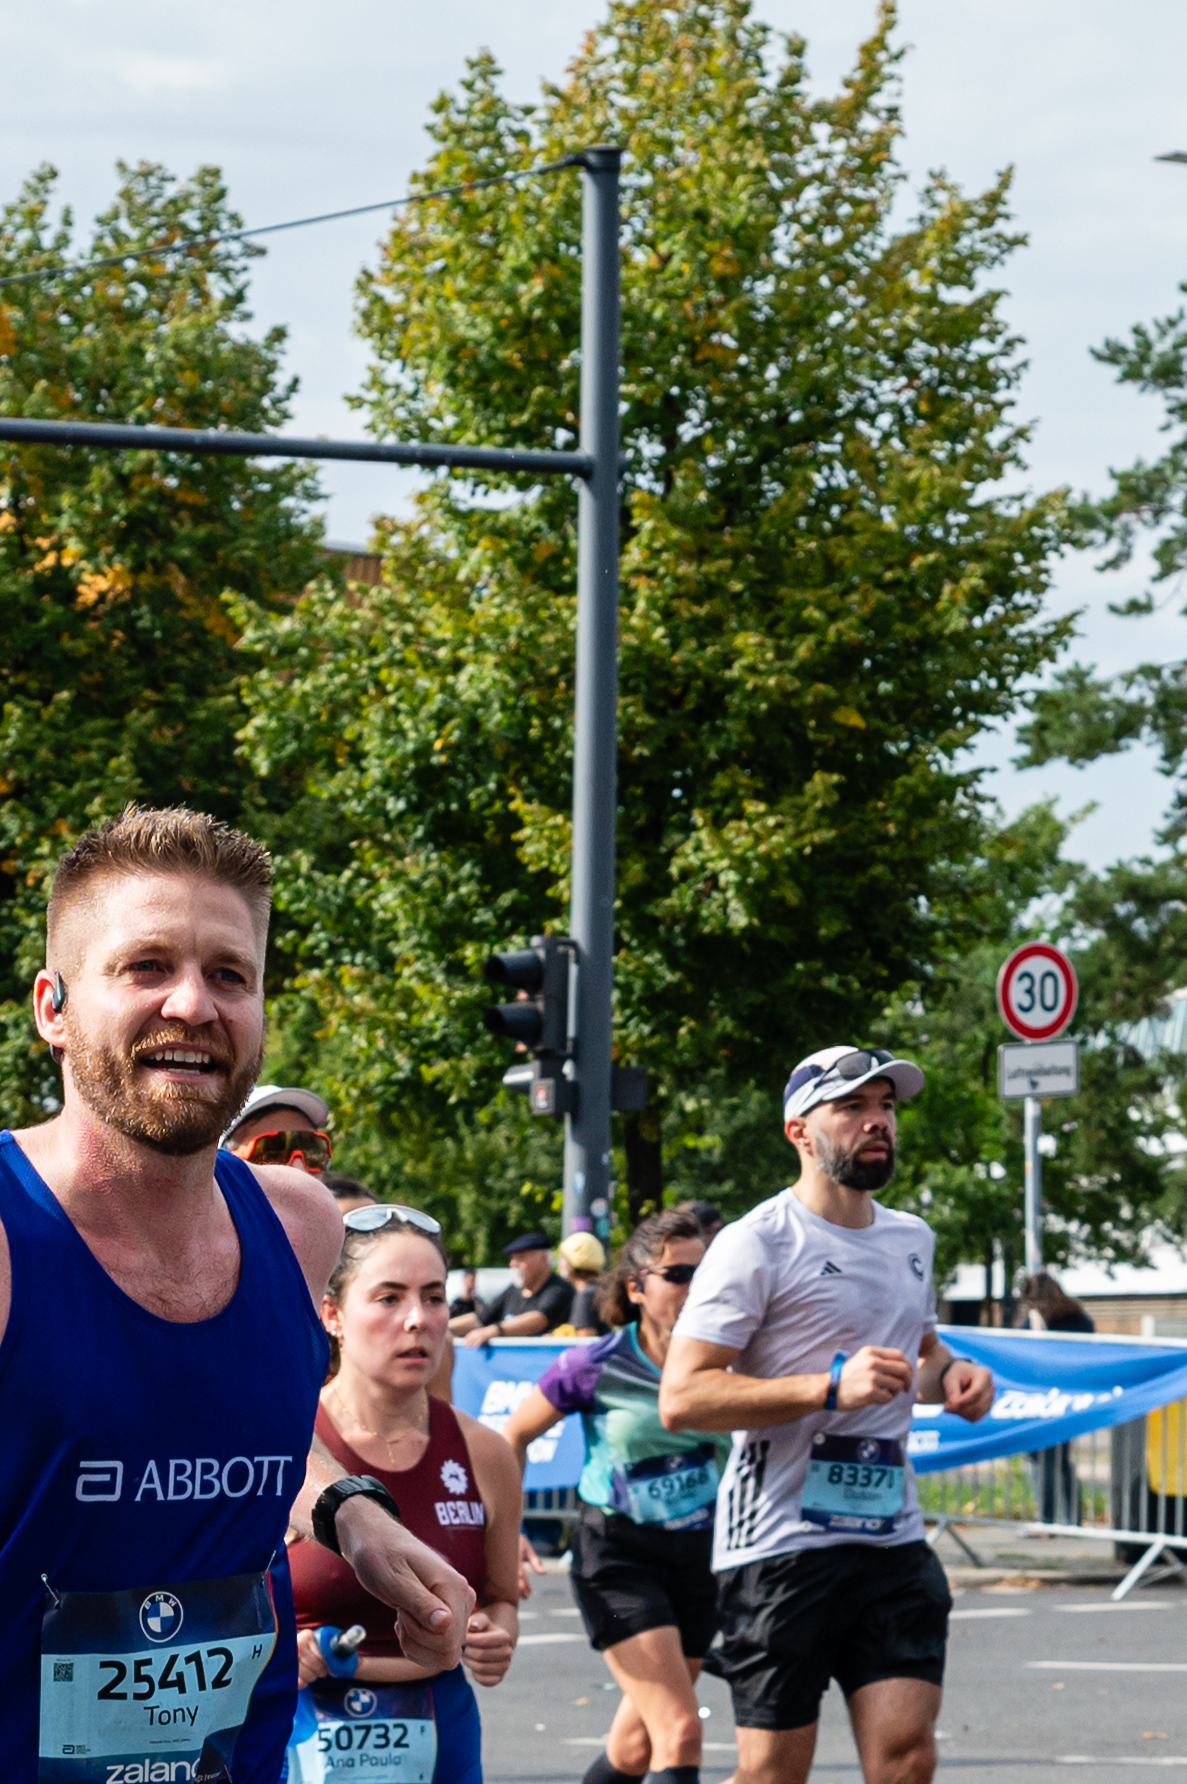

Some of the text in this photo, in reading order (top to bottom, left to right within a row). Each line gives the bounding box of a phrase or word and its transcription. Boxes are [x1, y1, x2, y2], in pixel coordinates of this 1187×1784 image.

[1017, 970, 1059, 1013] 30
[135, 1456, 292, 1501] ABBOTT
[434, 1501, 484, 1526] BERLIN
[97, 1644, 263, 1701] 25412 H
[143, 1704, 199, 1727] Tony
[318, 1723, 410, 1753] 50732
[325, 1752, 402, 1769] Ana Paula
